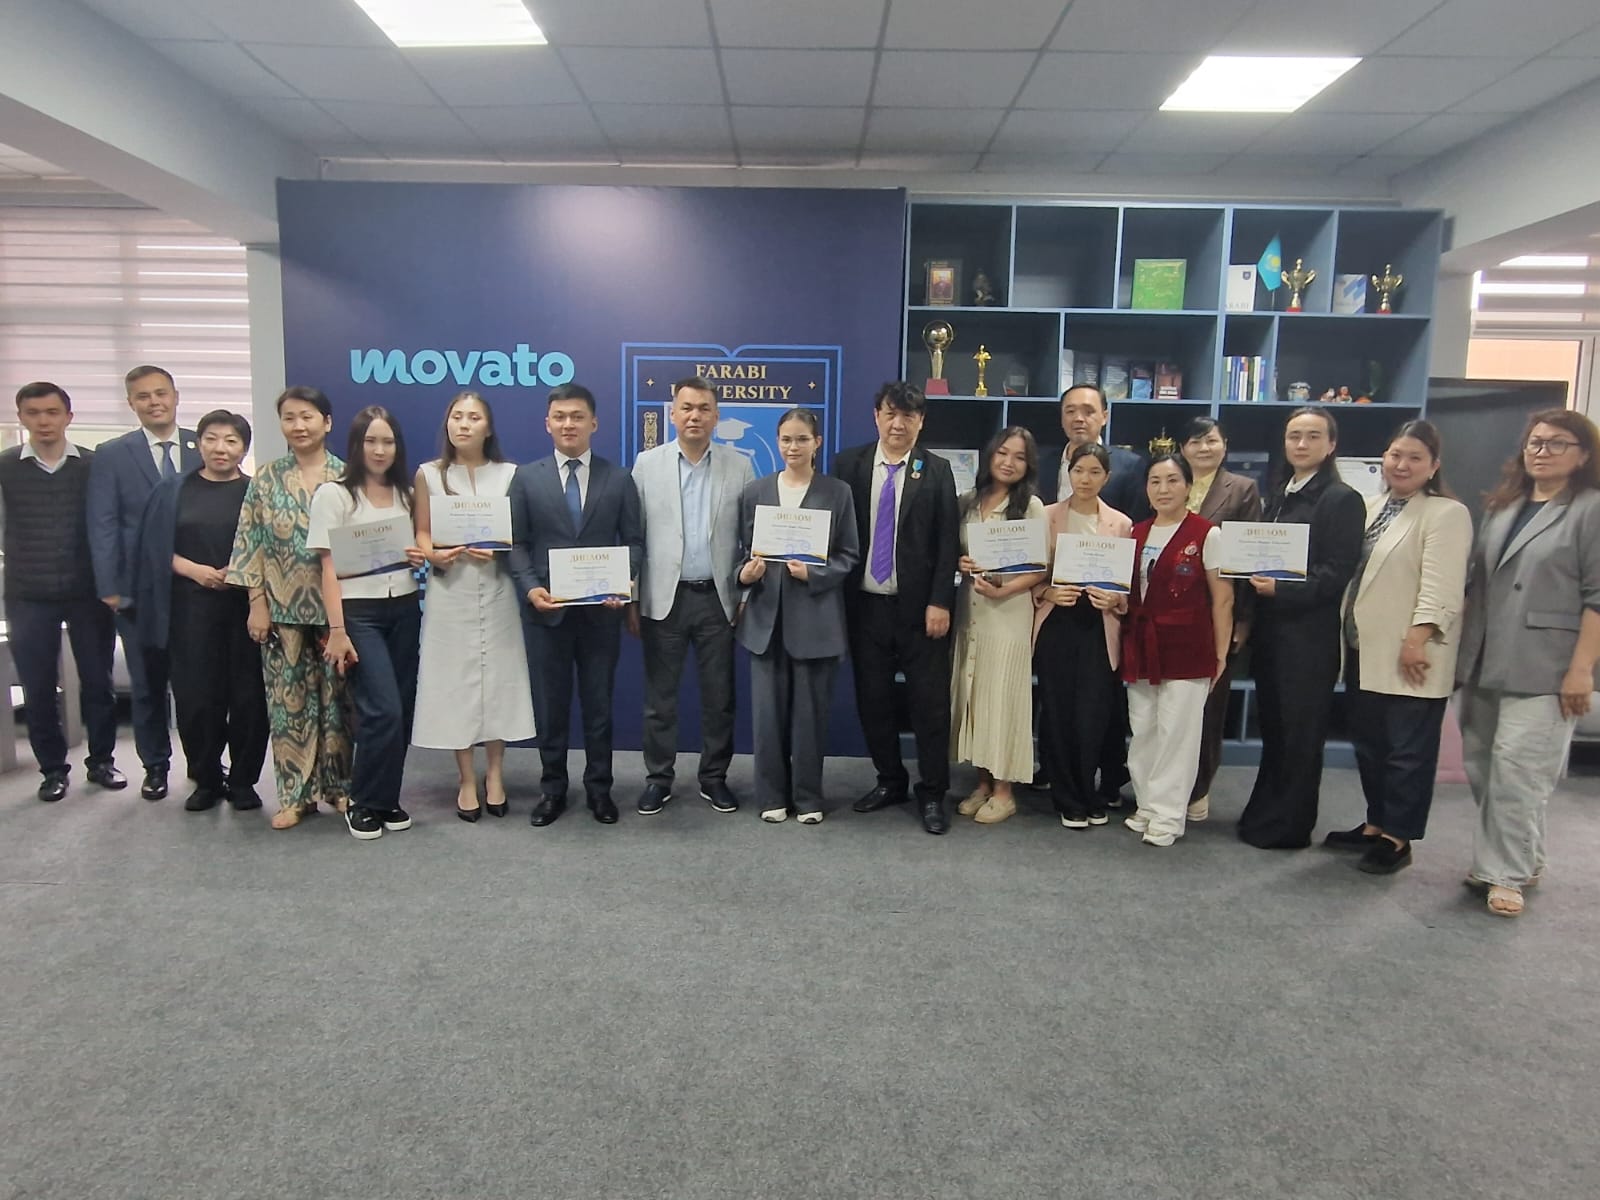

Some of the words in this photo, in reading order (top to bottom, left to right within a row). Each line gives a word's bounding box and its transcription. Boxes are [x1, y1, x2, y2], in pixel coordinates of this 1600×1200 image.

[350, 343, 575, 387] movato
[696, 364, 767, 379] FARABI
[352, 524, 393, 539] ДИПЛОМ
[987, 525, 1026, 536] ДИПЛОМ
